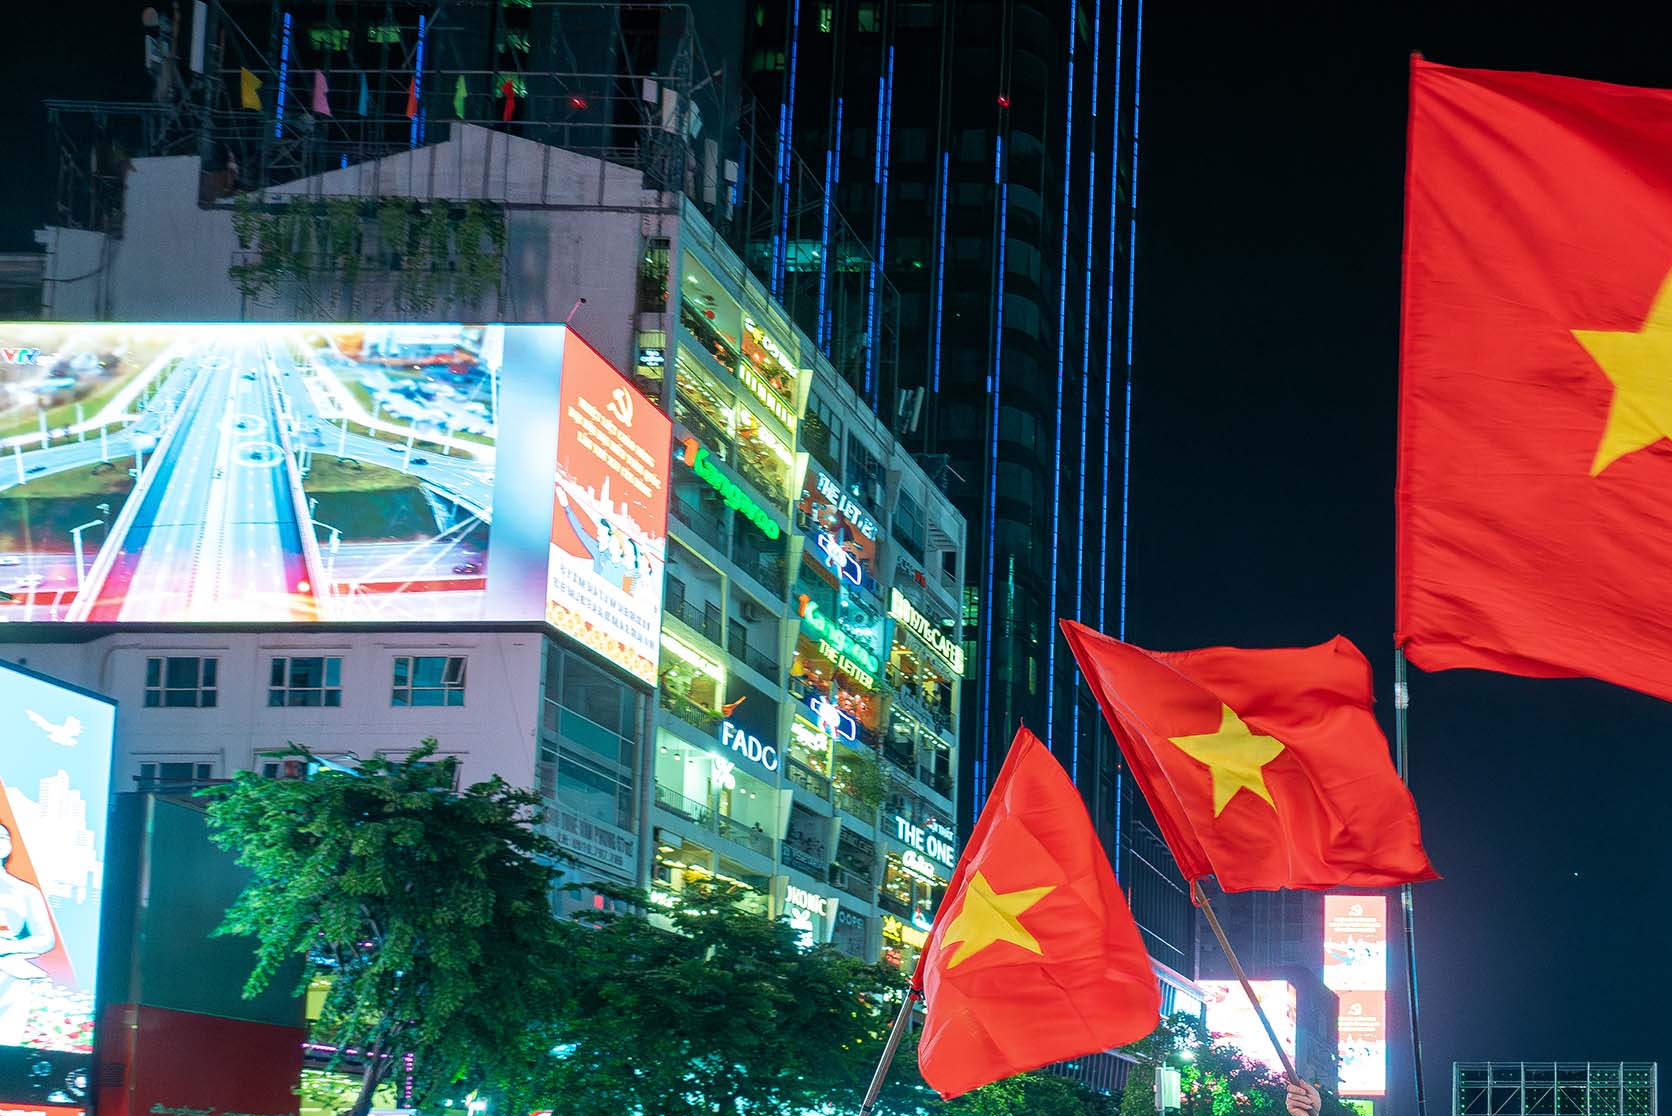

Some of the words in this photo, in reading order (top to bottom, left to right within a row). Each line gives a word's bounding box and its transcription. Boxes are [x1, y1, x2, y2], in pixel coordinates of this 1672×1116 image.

[722, 721, 778, 771] FADO
[896, 815, 926, 852] THE
[927, 836, 955, 869] ONE
